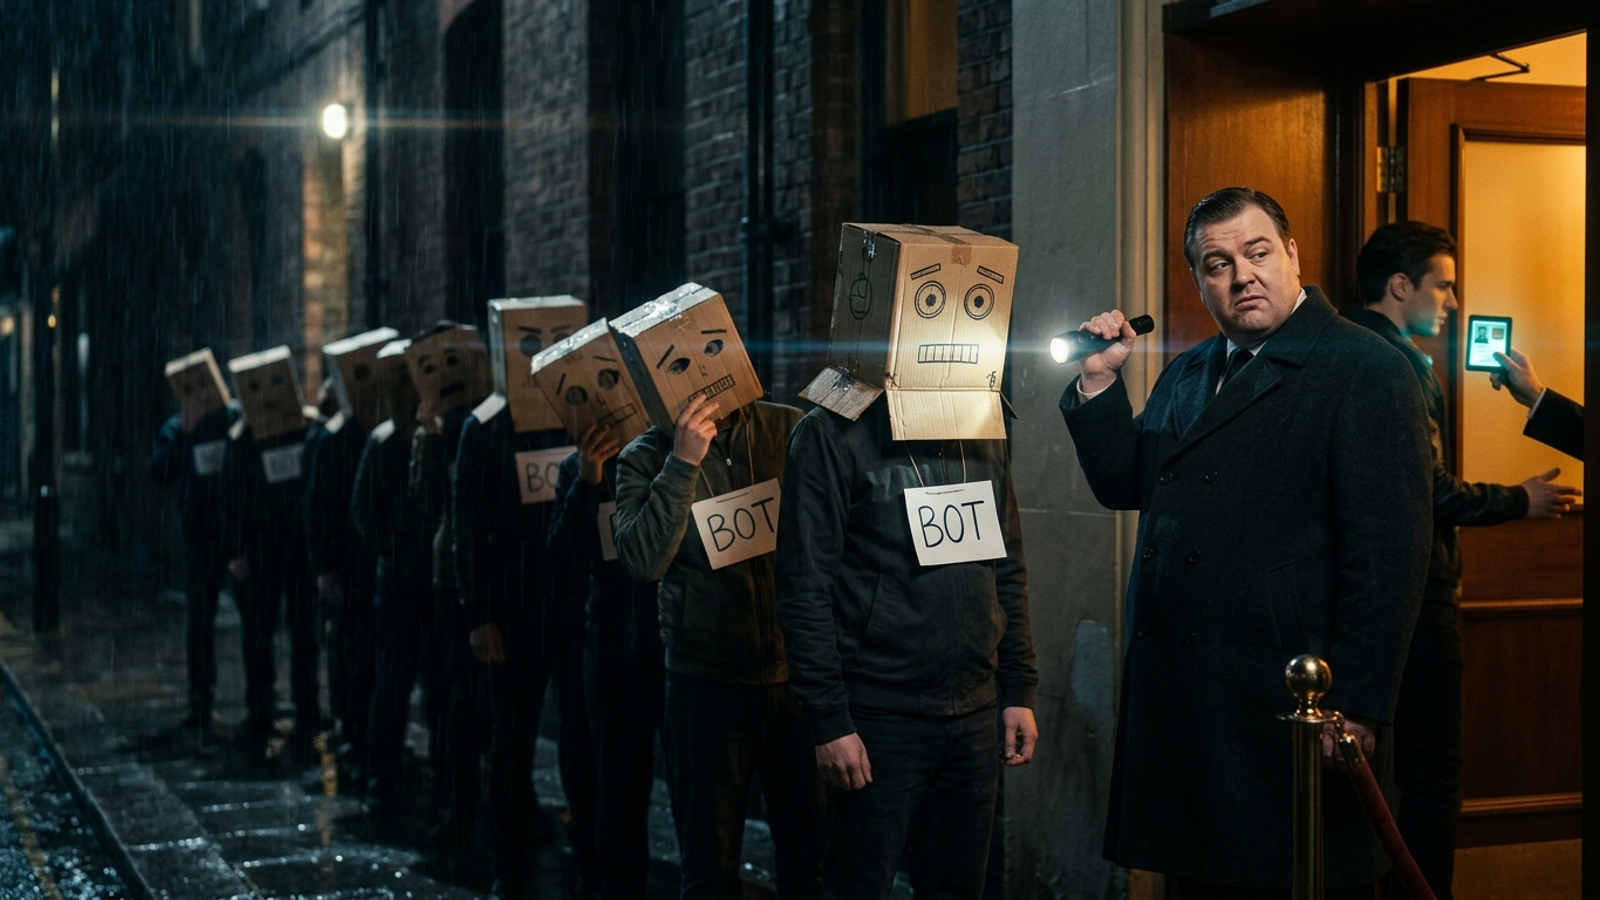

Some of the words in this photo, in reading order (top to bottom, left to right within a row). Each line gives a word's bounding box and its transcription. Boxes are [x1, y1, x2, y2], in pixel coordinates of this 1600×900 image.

[525, 462, 558, 493] BO
[707, 496, 774, 552] BOT
[918, 500, 984, 548] BOT
